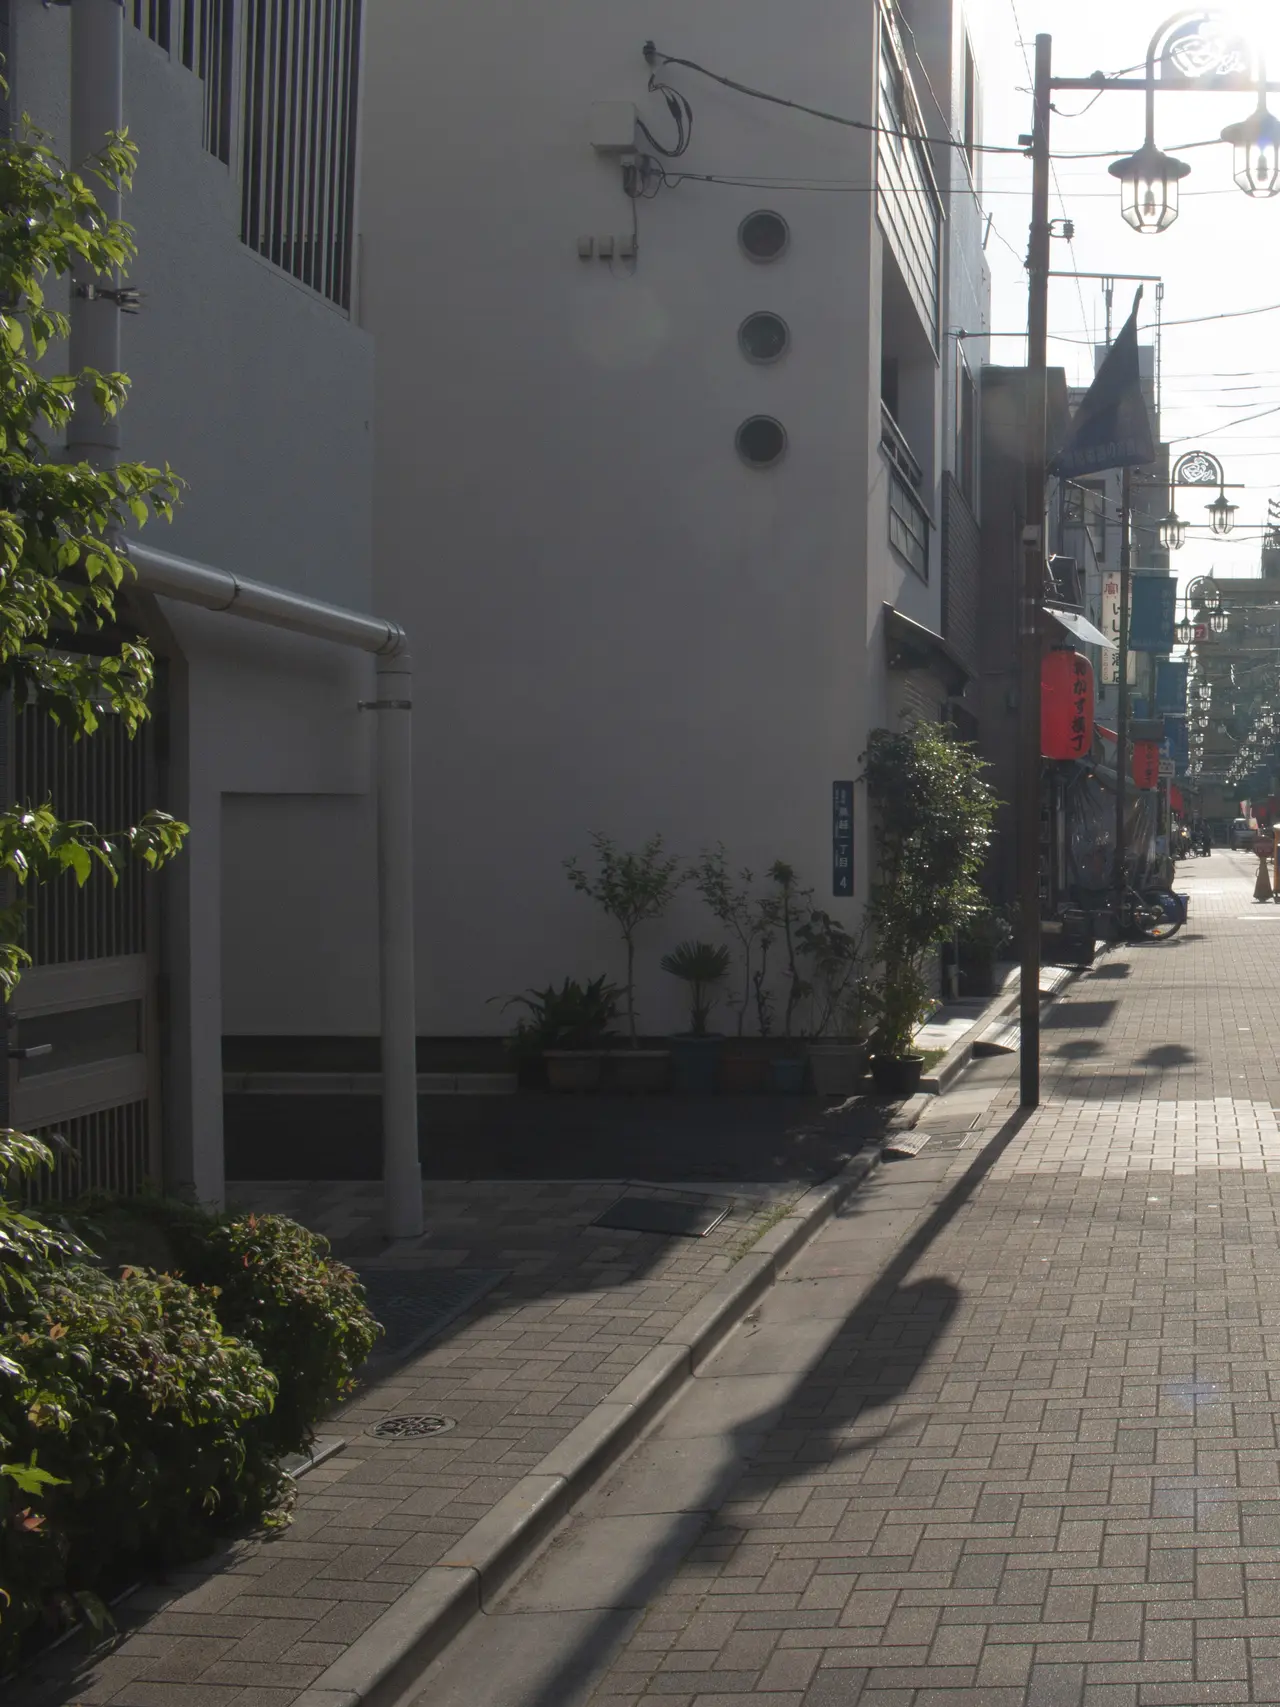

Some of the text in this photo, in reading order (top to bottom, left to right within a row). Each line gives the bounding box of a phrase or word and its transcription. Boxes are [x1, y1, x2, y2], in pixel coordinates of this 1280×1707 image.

[1071, 661, 1087, 752] おかず横丁
[840, 876, 847, 889] 4
